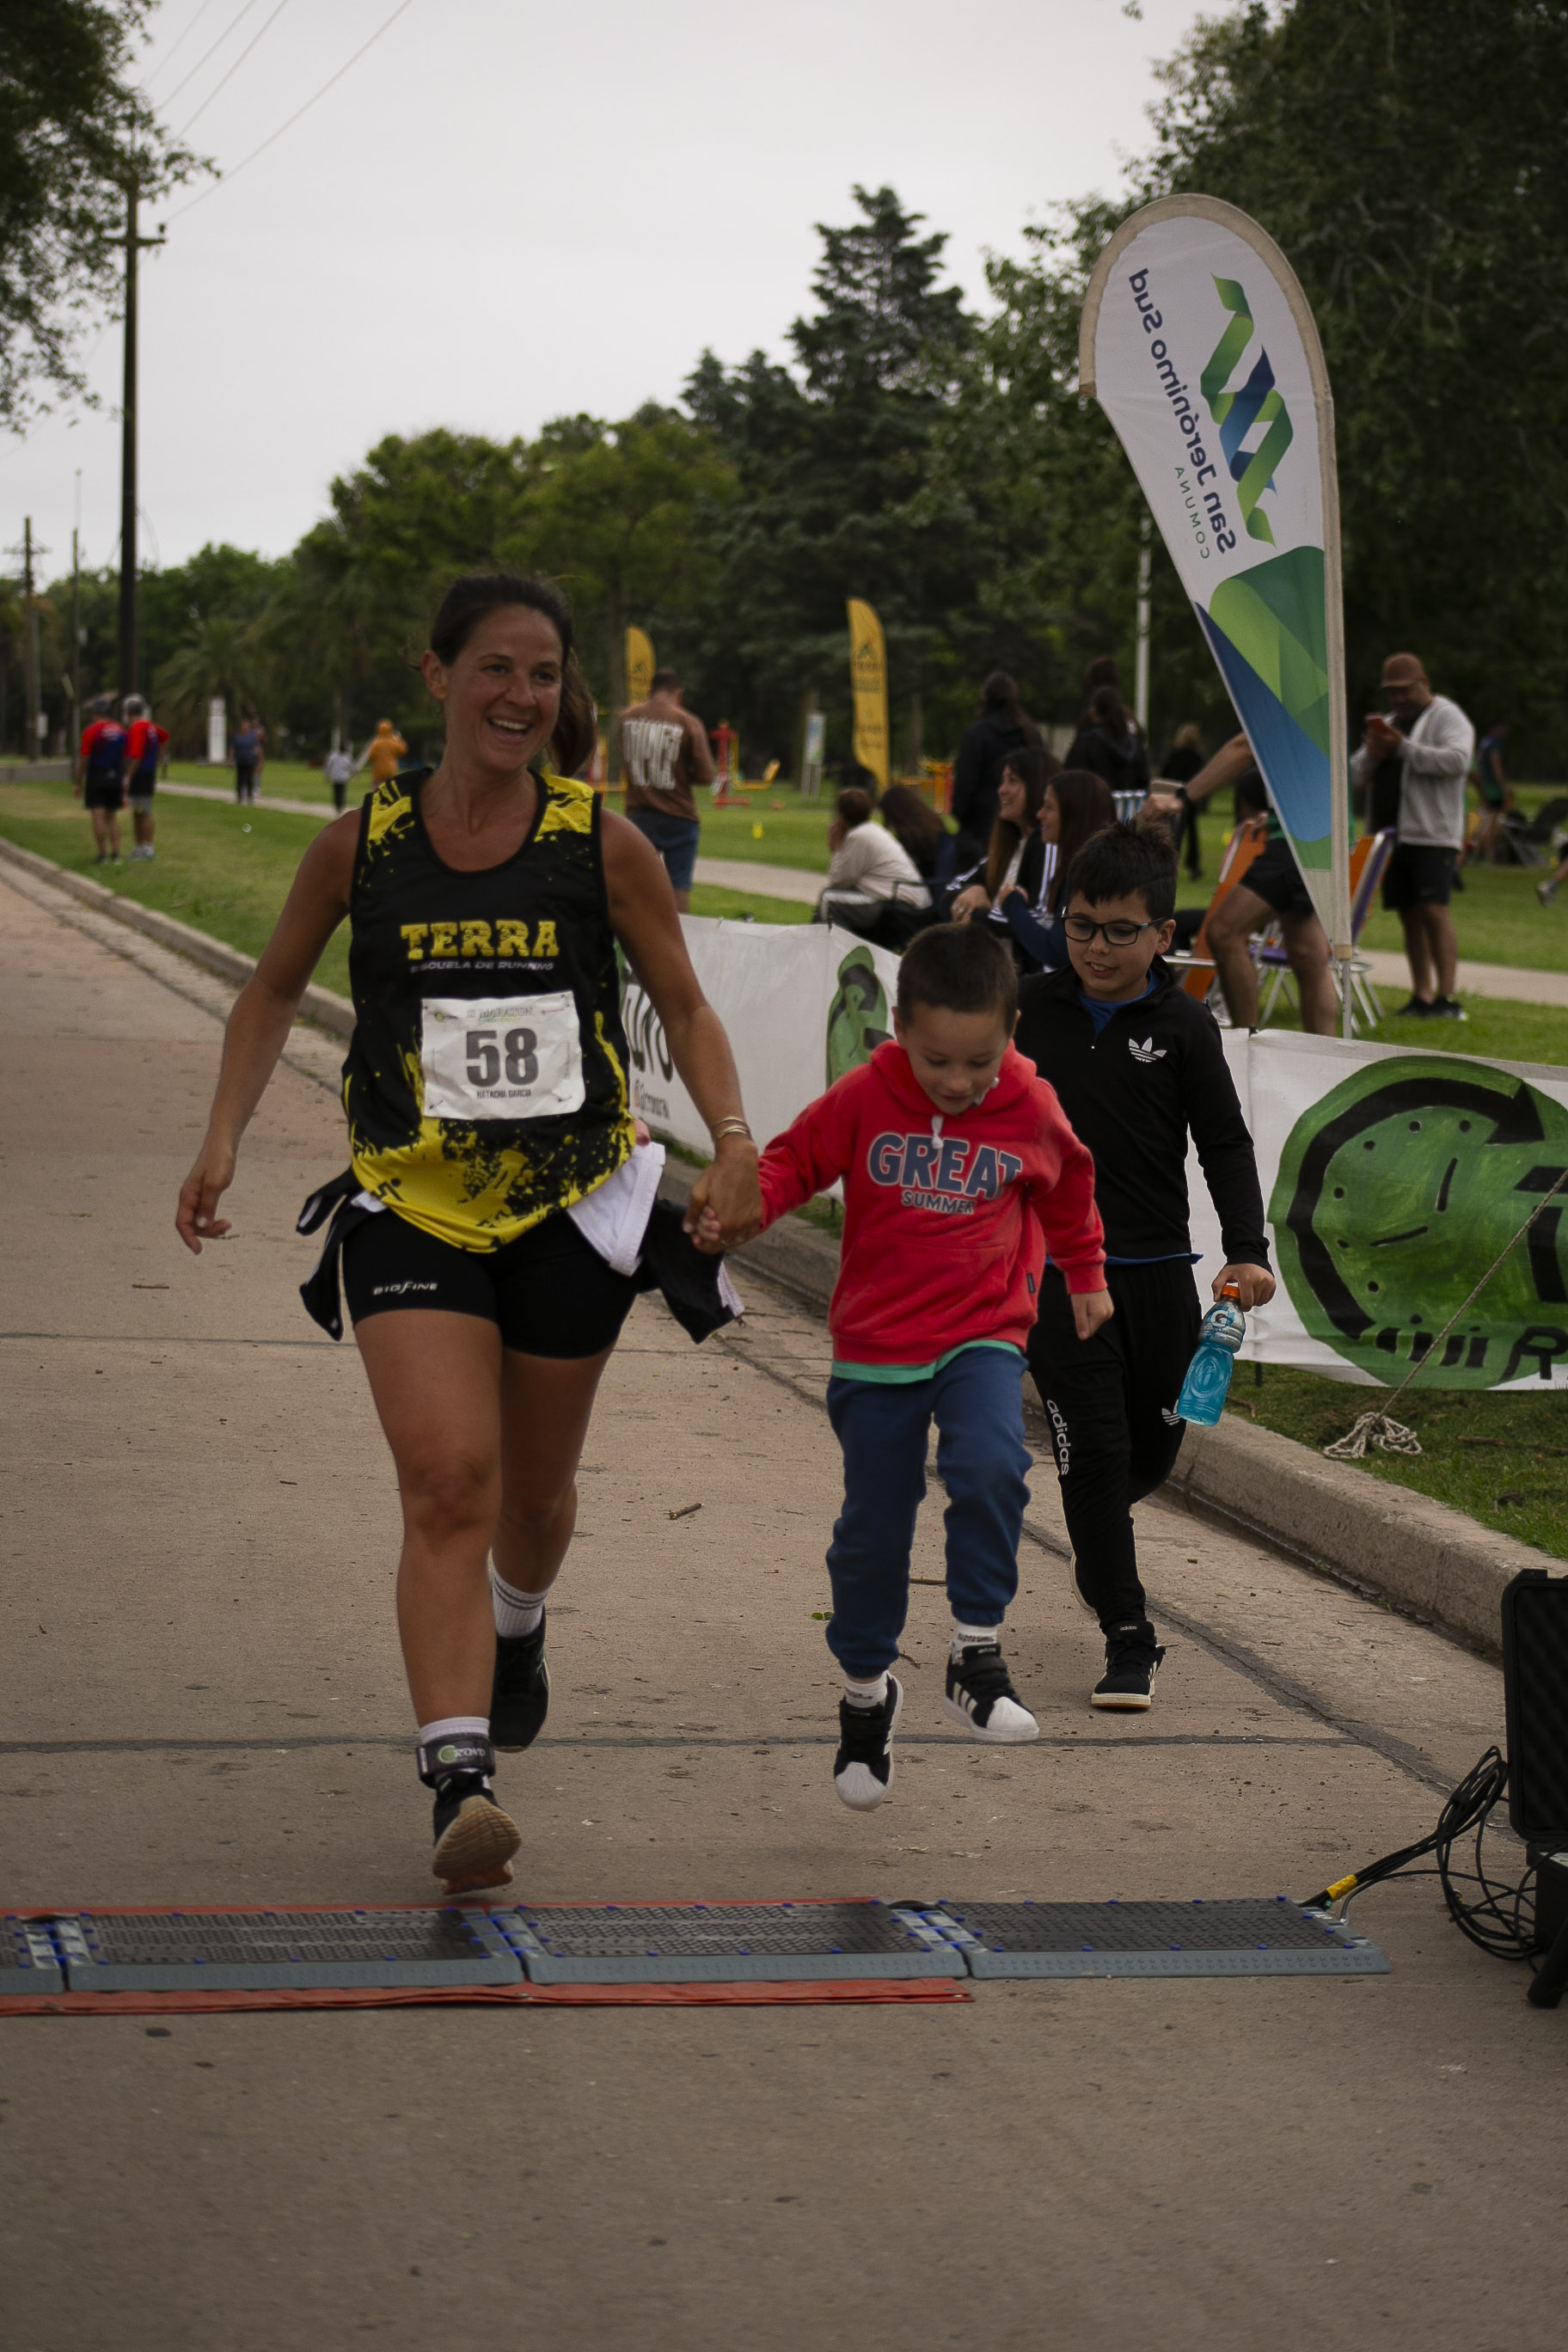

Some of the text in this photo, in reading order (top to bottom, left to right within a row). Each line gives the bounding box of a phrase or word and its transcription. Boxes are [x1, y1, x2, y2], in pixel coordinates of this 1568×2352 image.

[400, 918, 560, 960] TERRA
[410, 961, 555, 973] ESCUELA DE RUNNING
[465, 1027, 539, 1088] 58
[867, 1130, 1023, 1201] GREAT
[901, 1191, 977, 1215] SUMMER
[1046, 1399, 1072, 1475] adidas
